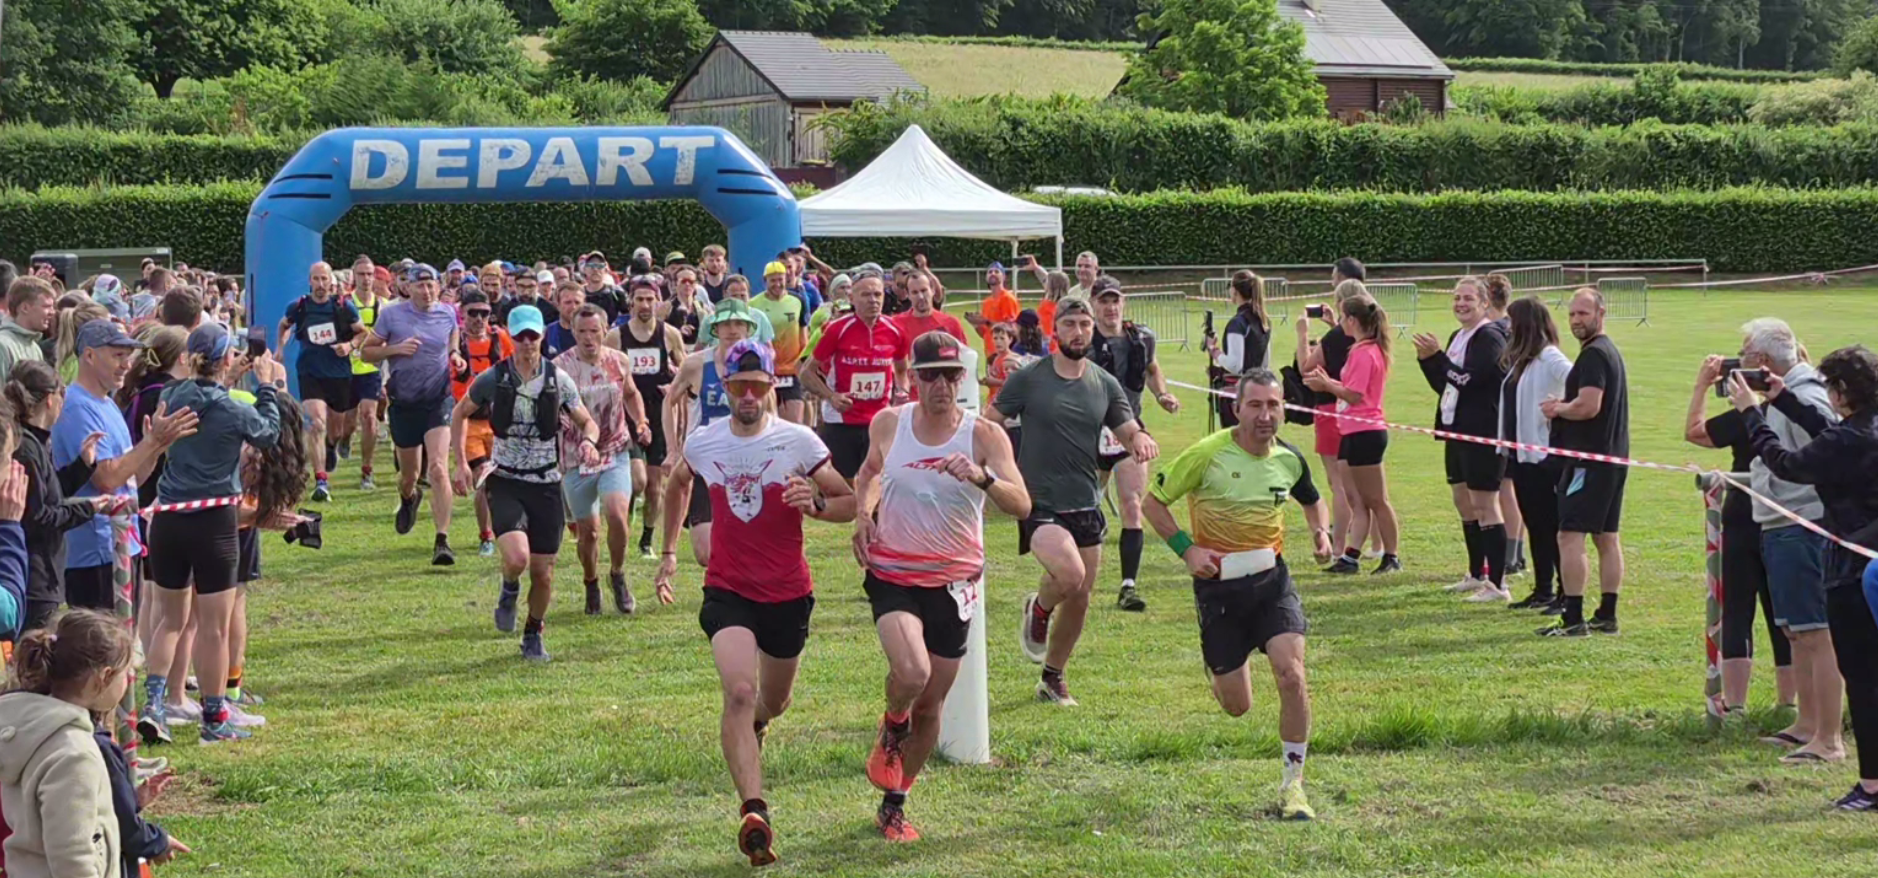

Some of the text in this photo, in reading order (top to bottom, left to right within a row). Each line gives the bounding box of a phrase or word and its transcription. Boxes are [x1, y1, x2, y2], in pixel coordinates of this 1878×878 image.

[350, 137, 715, 190] DEPART
[313, 329, 331, 341] 144
[634, 356, 656, 367] 193
[856, 381, 880, 392] 147
